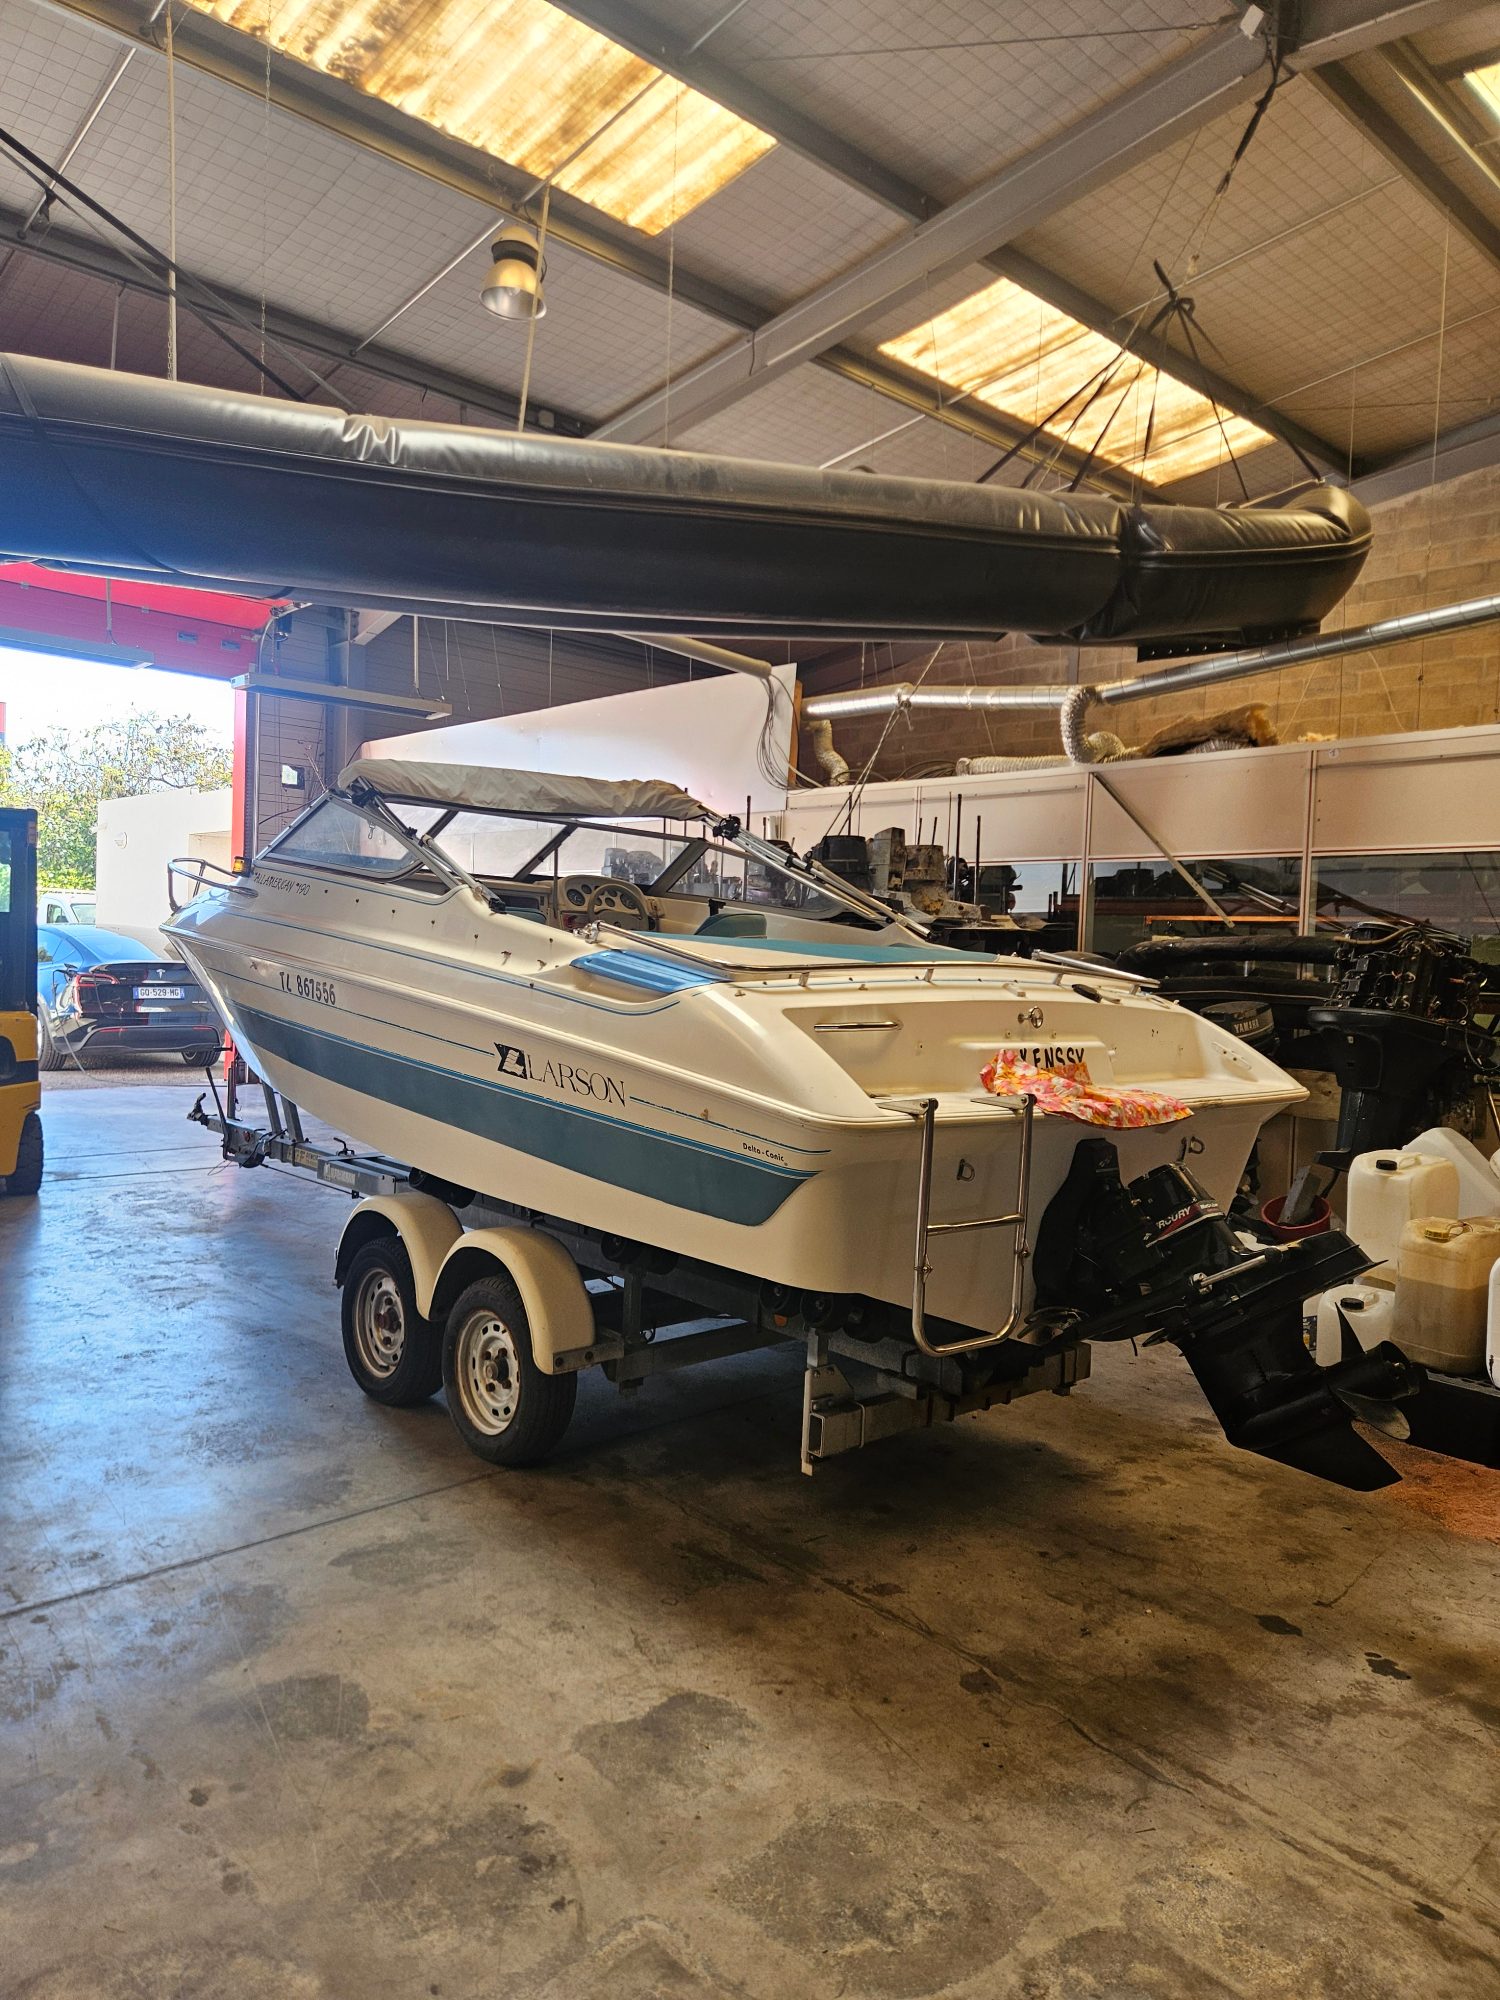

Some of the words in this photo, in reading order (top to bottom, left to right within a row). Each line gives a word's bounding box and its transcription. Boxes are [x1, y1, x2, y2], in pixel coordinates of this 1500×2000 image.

[279, 971, 292, 992] TL
[296, 974, 336, 1005] 867556
[527, 1053, 626, 1107] LARSON
